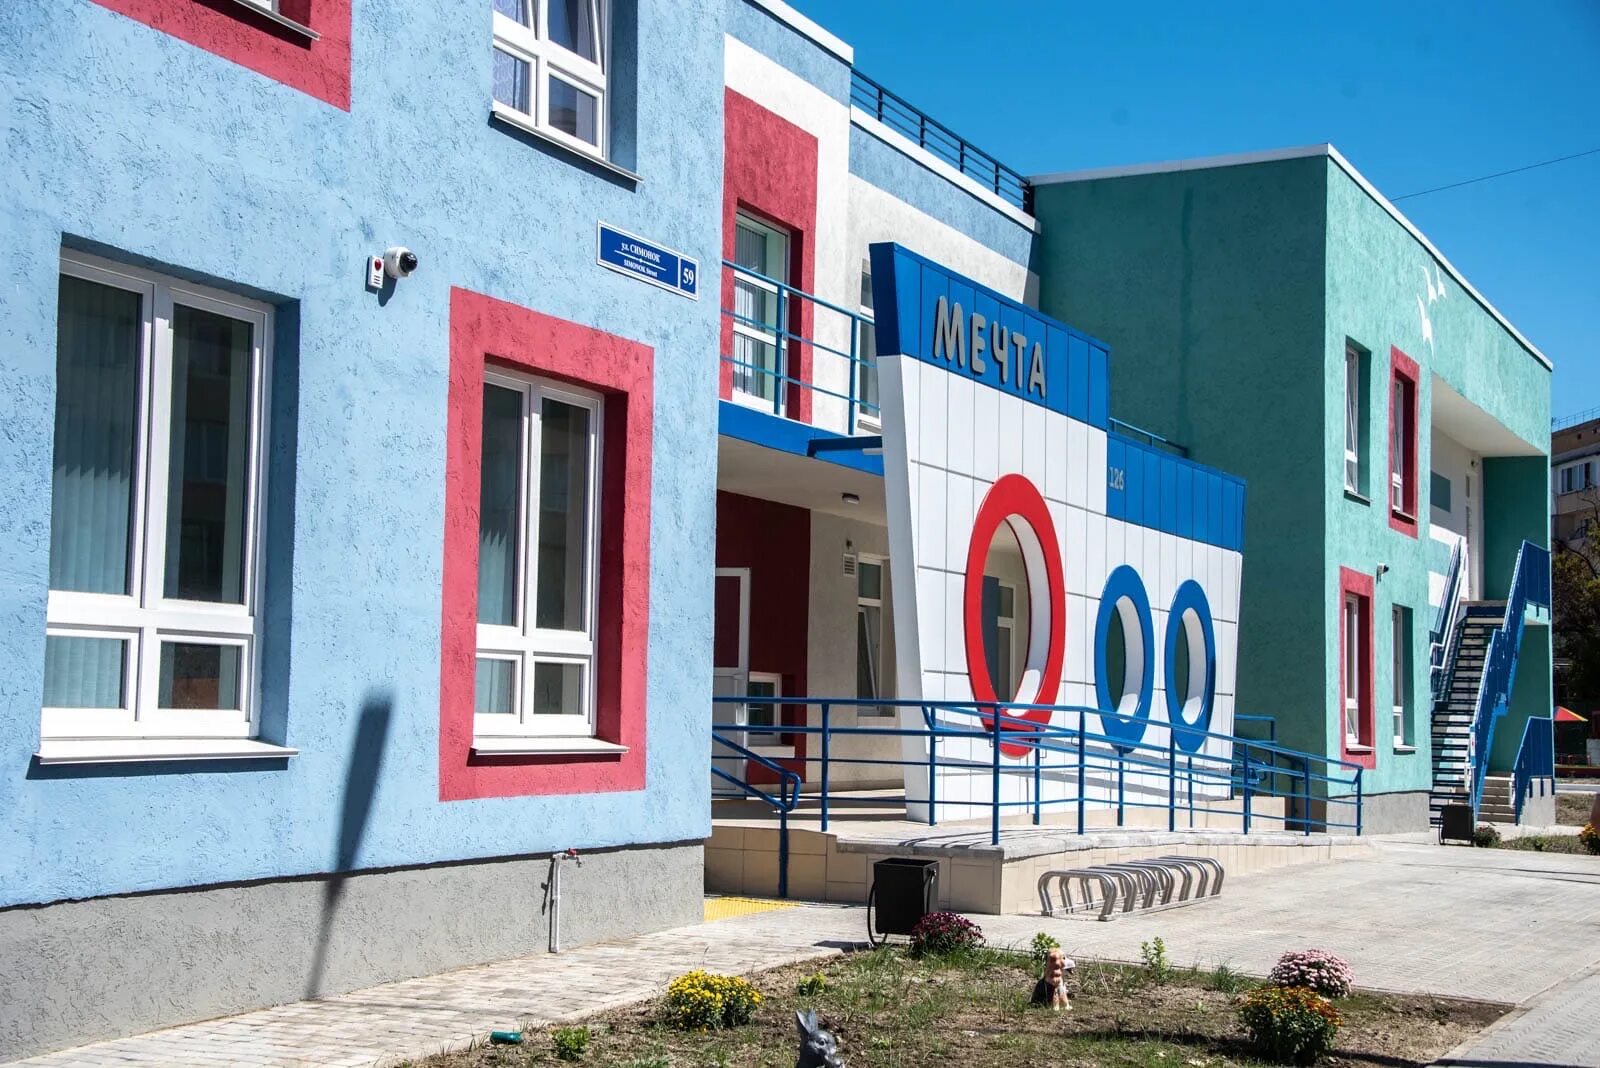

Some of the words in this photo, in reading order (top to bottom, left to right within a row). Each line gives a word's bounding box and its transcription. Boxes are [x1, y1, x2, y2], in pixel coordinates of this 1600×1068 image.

[630, 243, 660, 263] СИМОНОК
[623, 259, 645, 273] SIMONOK
[683, 267, 694, 286] 59
[933, 295, 1047, 399] МЕЧТА
